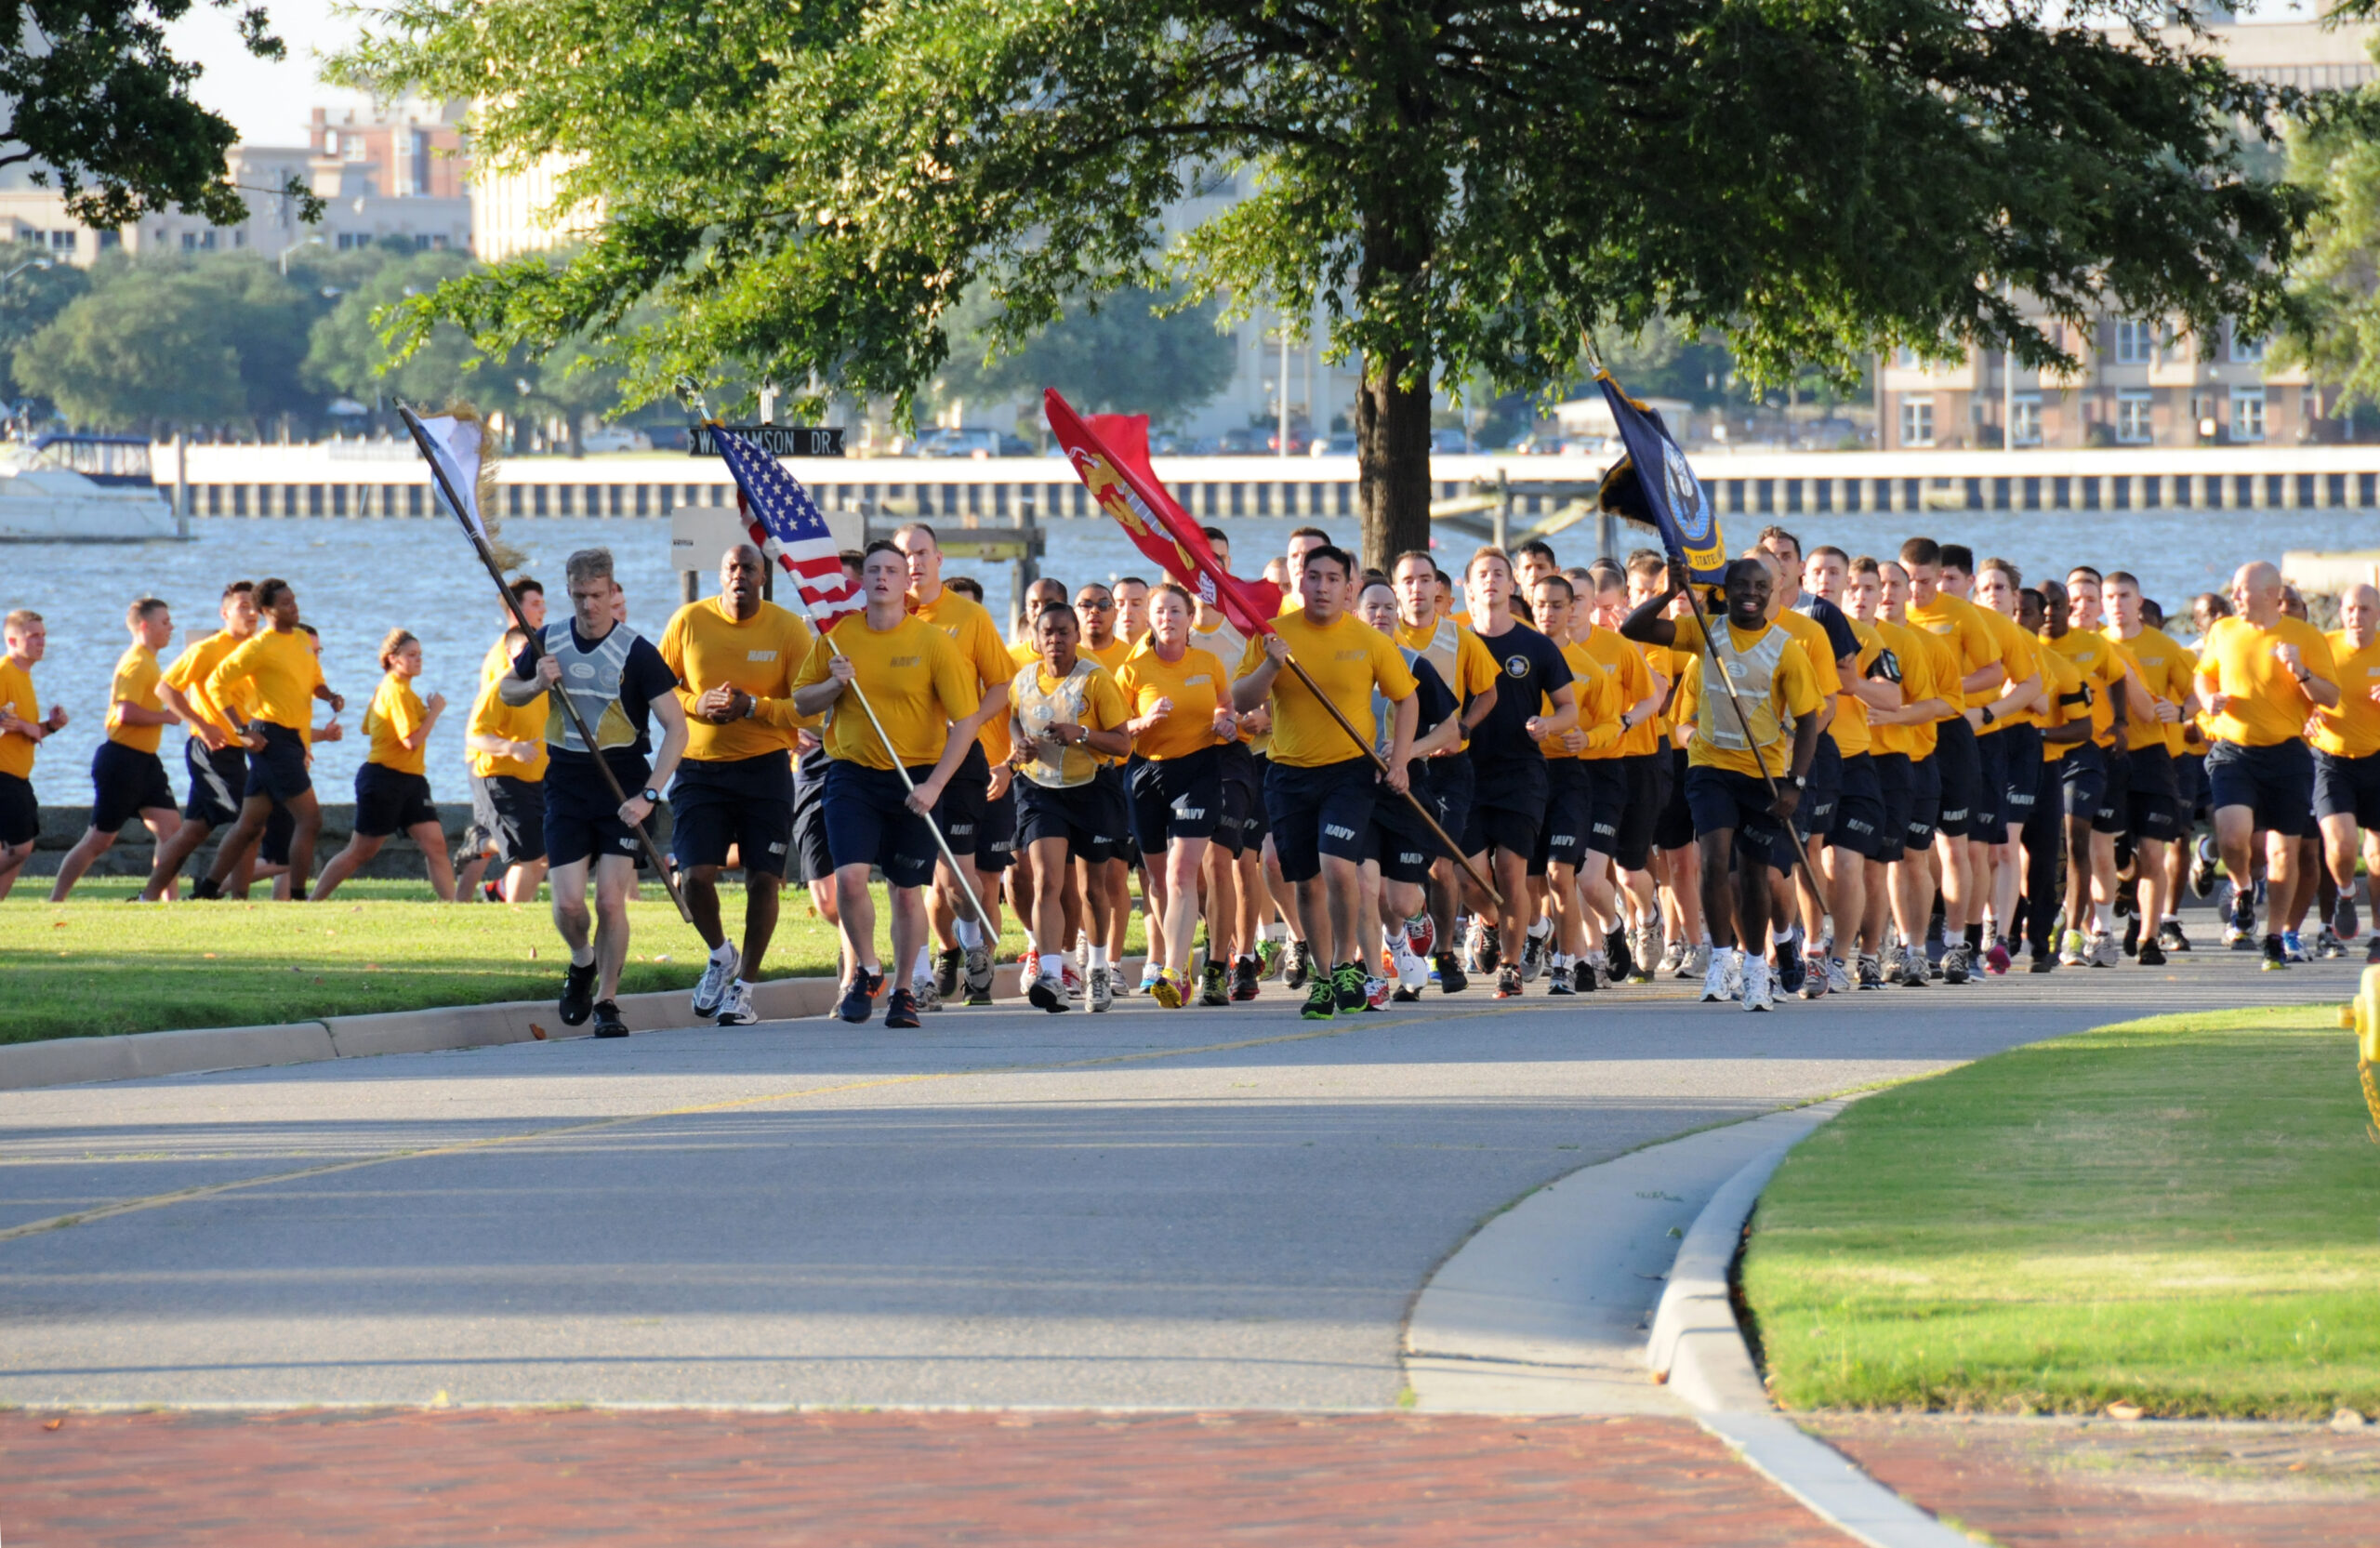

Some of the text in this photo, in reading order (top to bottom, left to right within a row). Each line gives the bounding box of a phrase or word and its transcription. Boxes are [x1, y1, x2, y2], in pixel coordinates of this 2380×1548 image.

[698, 430, 837, 455] WIAMSON DR.
[747, 650, 778, 662] NAVY
[889, 655, 922, 668] NAVY
[1175, 808, 1206, 821] NAVY
[1942, 806, 1969, 821] NAVY
[1324, 823, 1356, 841] NAVY
